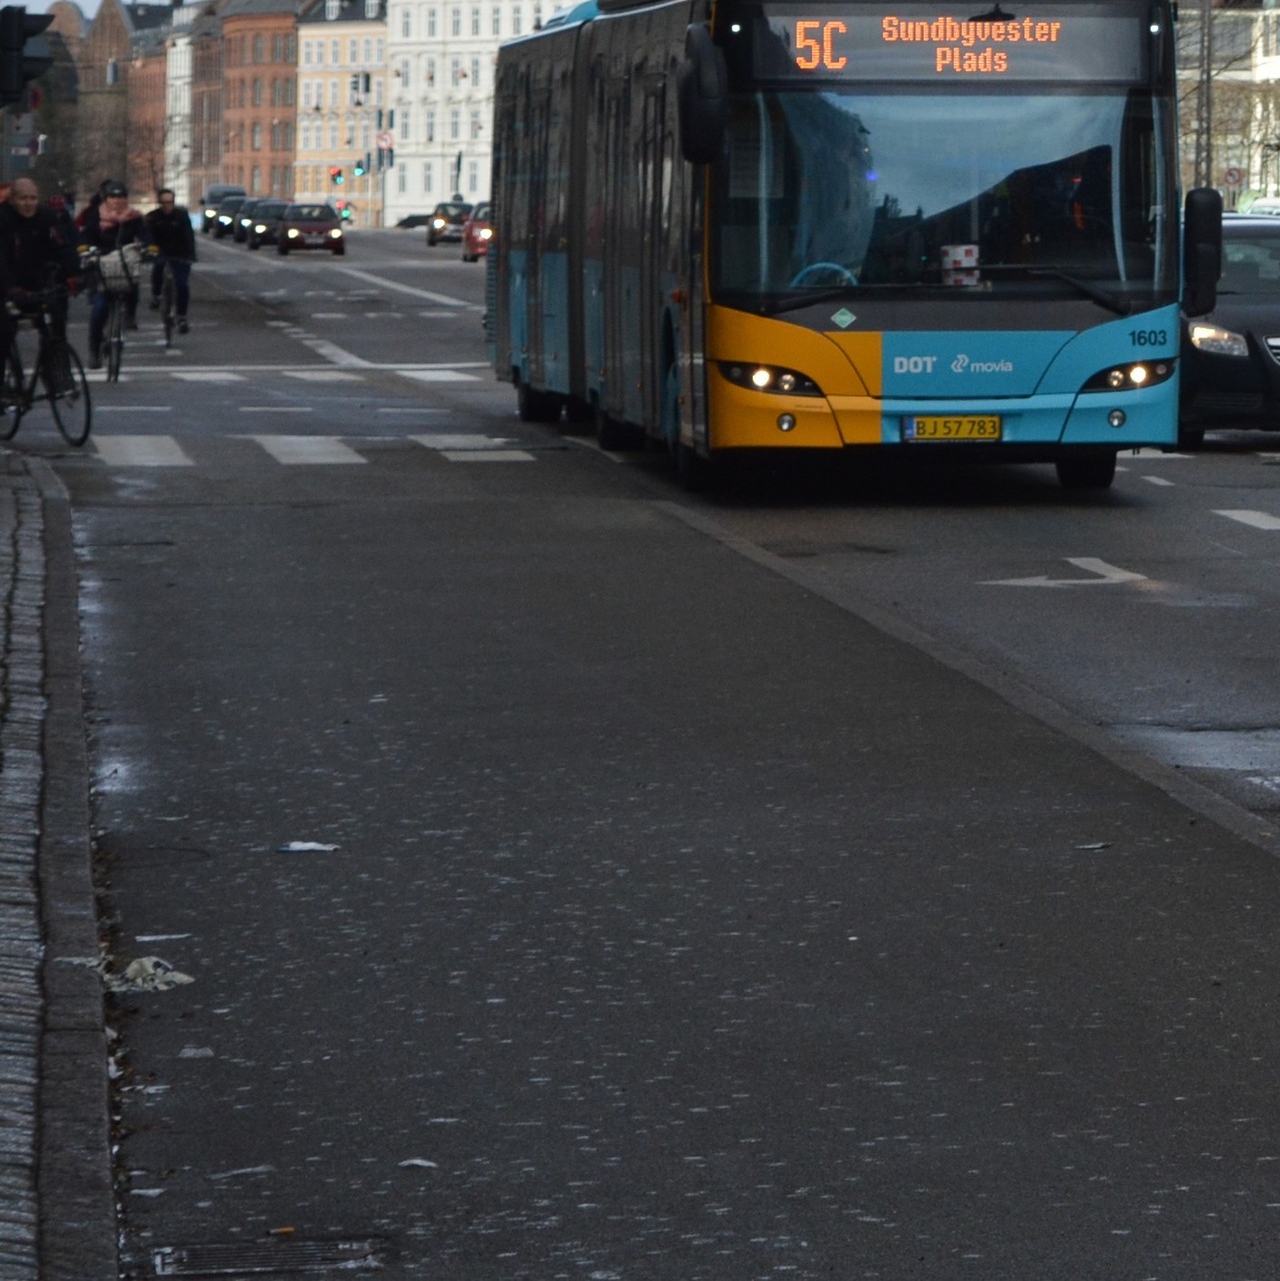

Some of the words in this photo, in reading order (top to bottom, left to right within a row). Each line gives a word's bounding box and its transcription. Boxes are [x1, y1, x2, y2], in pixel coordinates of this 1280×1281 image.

[882, 16, 1061, 46] Sundbyvester
[796, 21, 847, 69] 5C
[936, 47, 1008, 72] Plads
[1129, 329, 1167, 346] 1603
[894, 356, 937, 373] DOT
[971, 358, 1013, 372] movia
[916, 422, 938, 436] BJ
[943, 421, 964, 436] 57
[970, 421, 997, 436] 783
